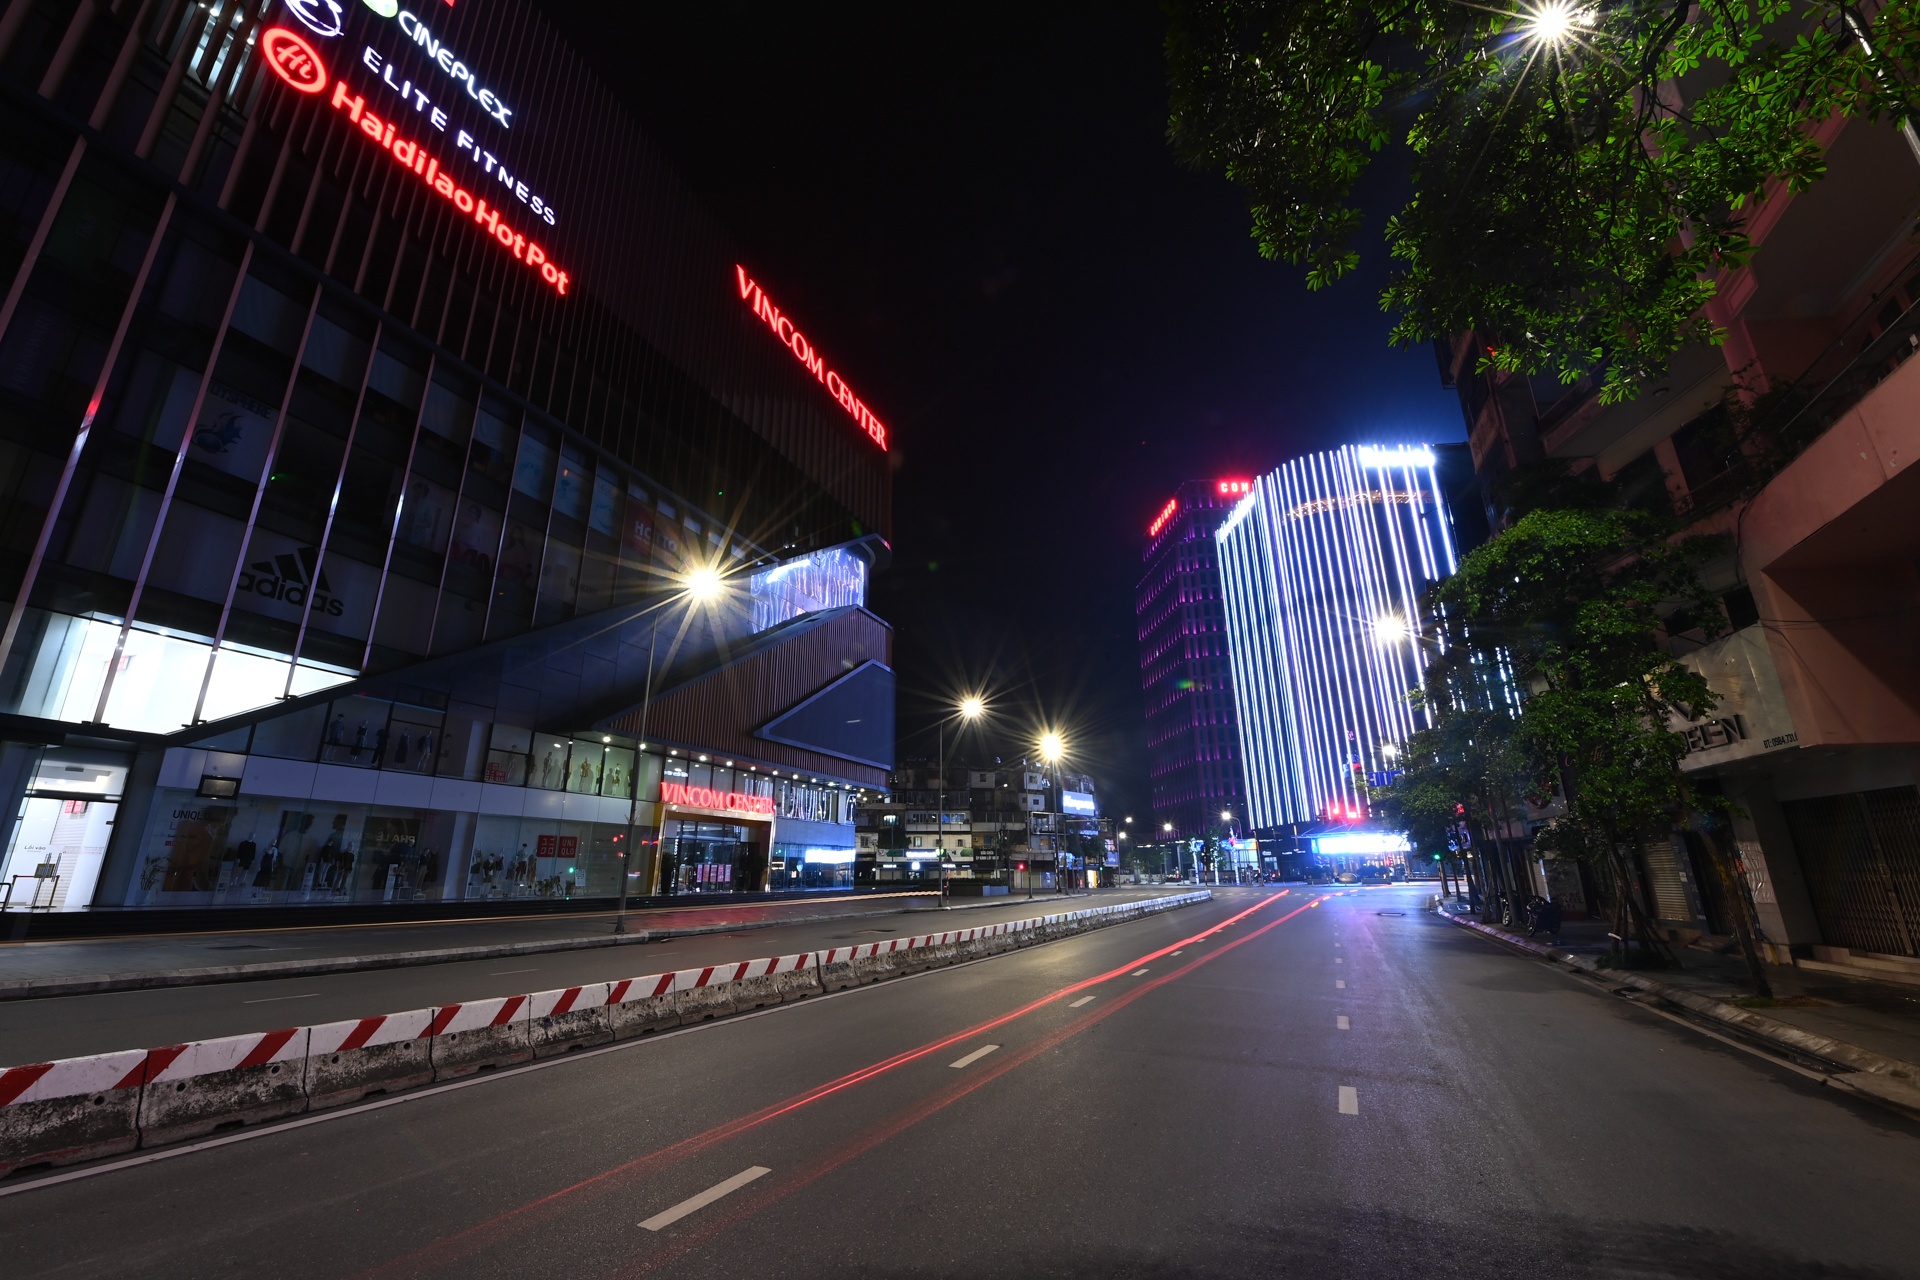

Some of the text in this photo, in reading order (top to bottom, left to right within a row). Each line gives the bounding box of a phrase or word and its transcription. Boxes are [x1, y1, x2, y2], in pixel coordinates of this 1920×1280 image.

[398, 10, 513, 128] CINEPLEX
[363, 45, 556, 226] ELITE FITNESS
[331, 81, 569, 295] Haidilao Hot Pot
[736, 264, 888, 452] VINCOM CENTER
[237, 572, 344, 618] adidas
[661, 782, 775, 816] VINCOM CENTER
[561, 847, 575, 856] QLO
[562, 839, 575, 847] UNI
